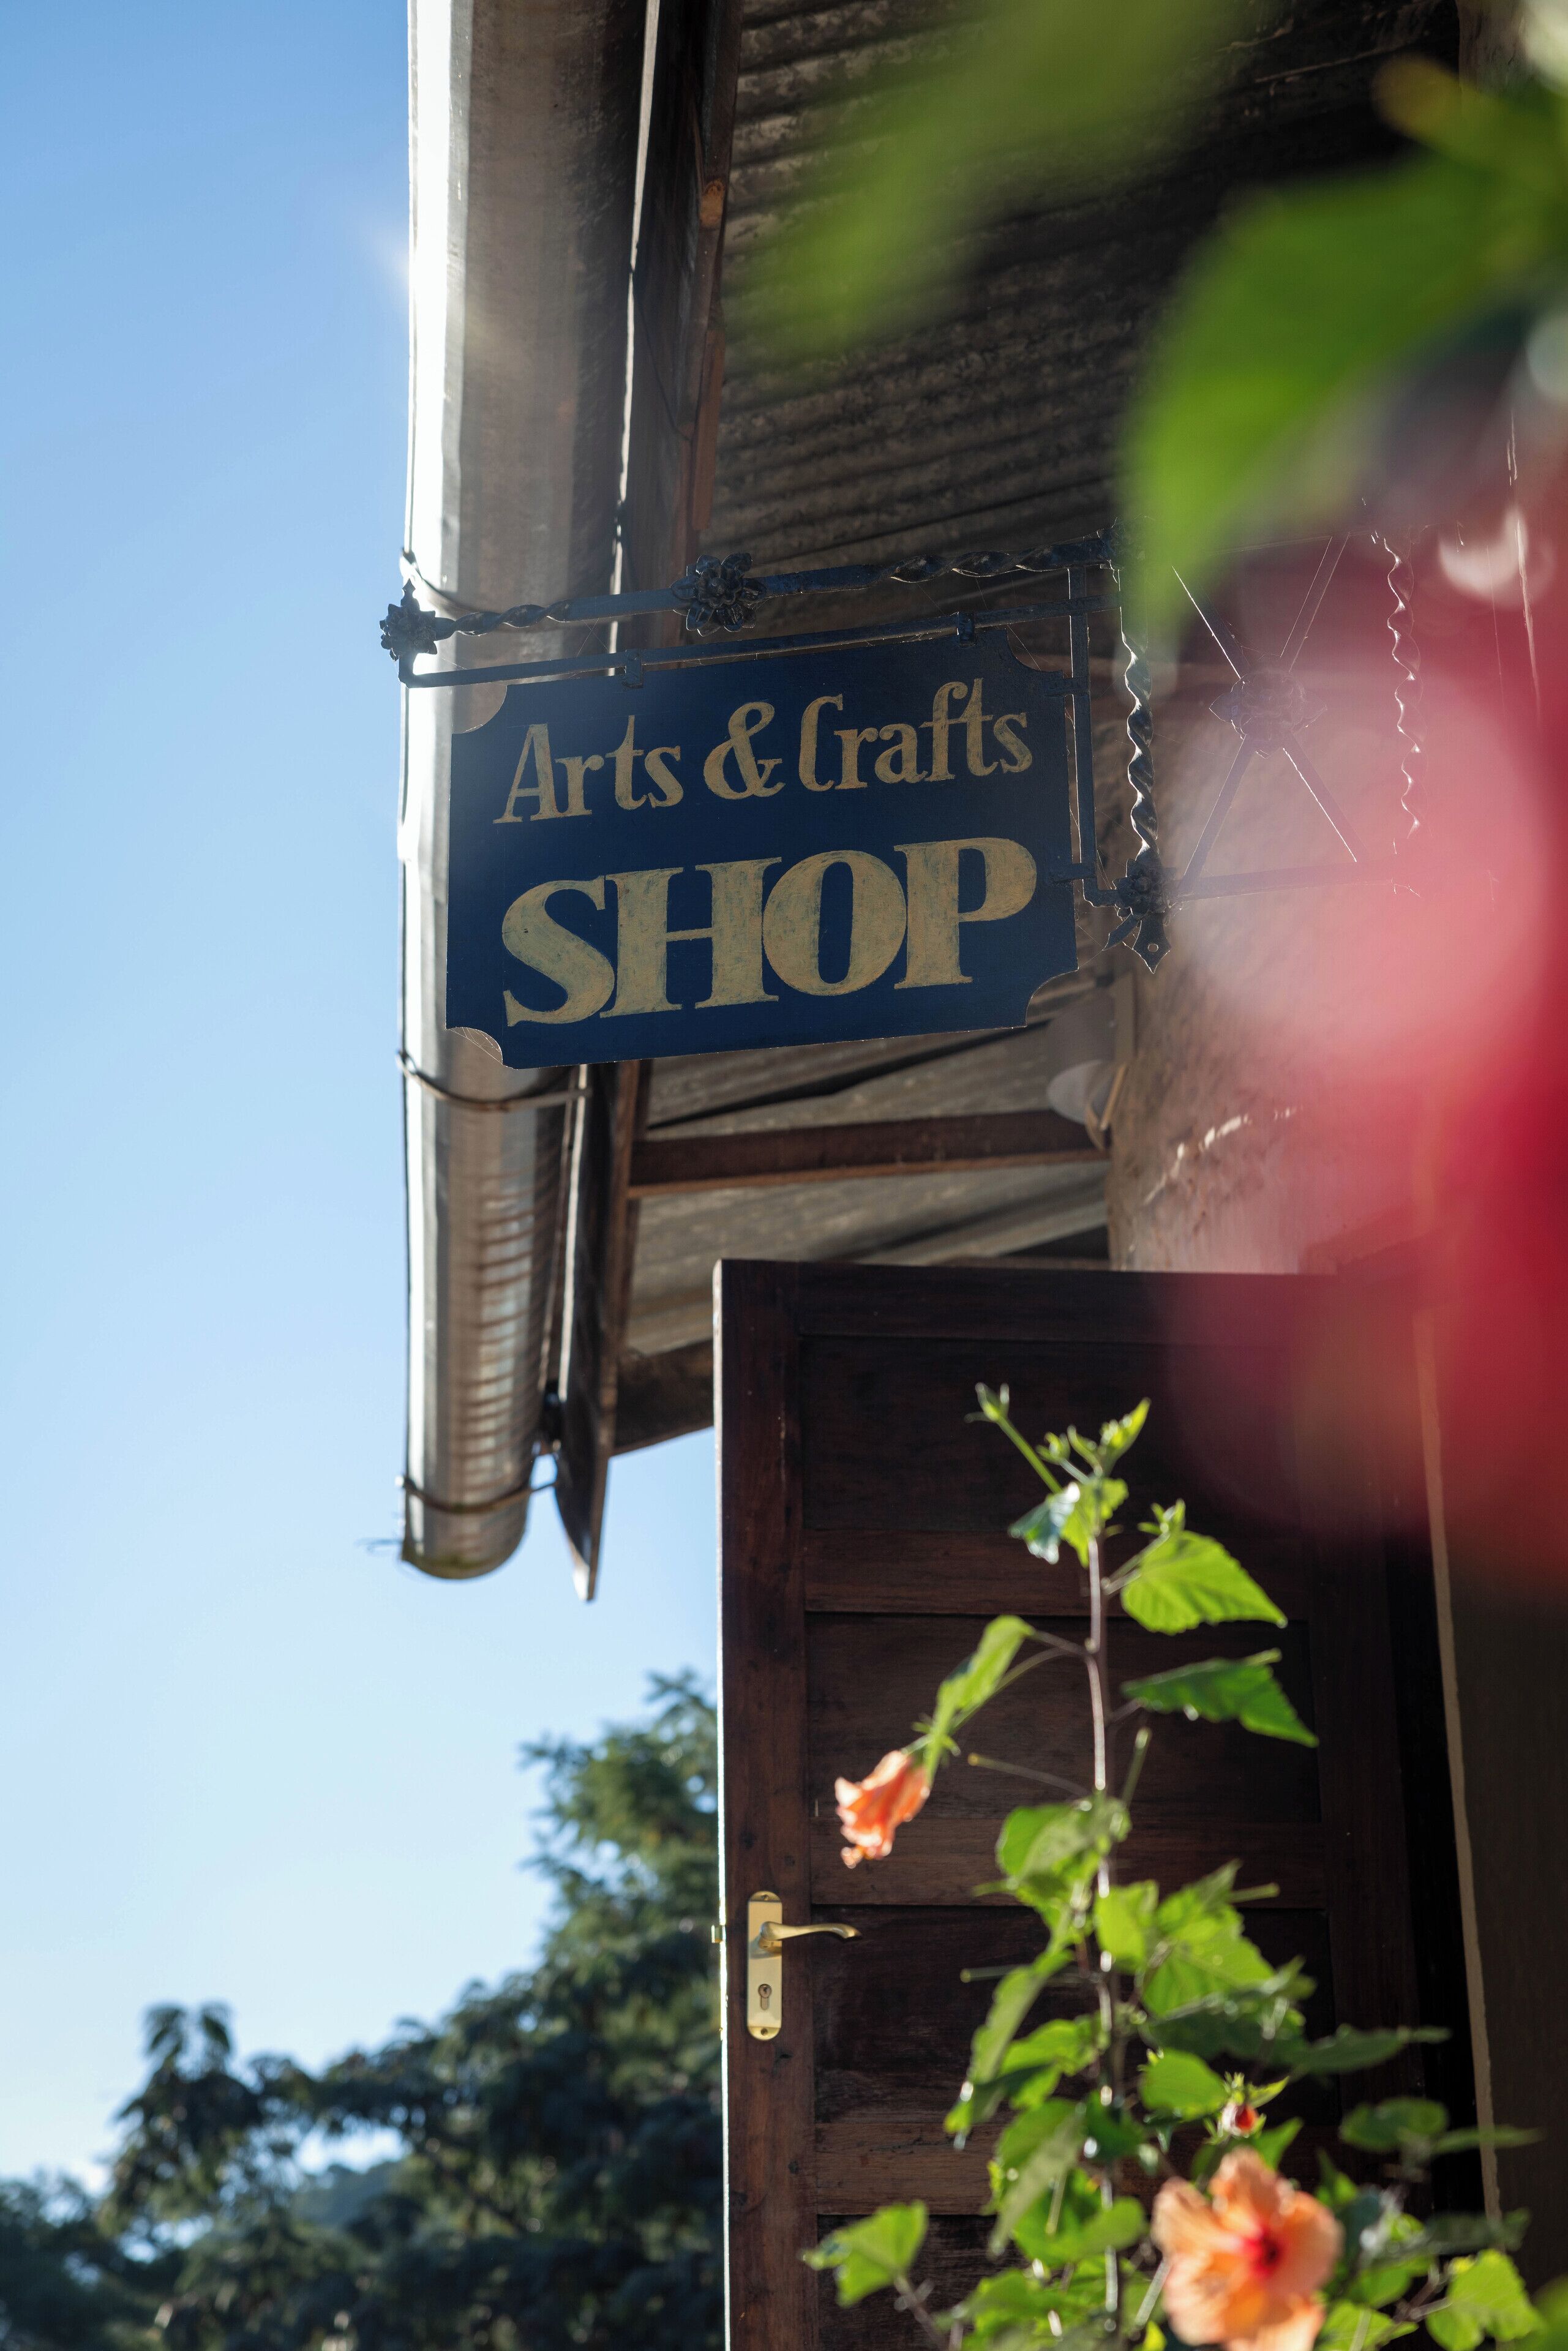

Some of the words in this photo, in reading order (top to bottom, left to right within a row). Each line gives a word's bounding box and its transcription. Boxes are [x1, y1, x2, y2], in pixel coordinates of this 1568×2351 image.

[493, 714, 685, 824] Arts
[703, 701, 786, 800] &
[798, 678, 1033, 792] Crafts
[501, 837, 1037, 1027] SHOP
